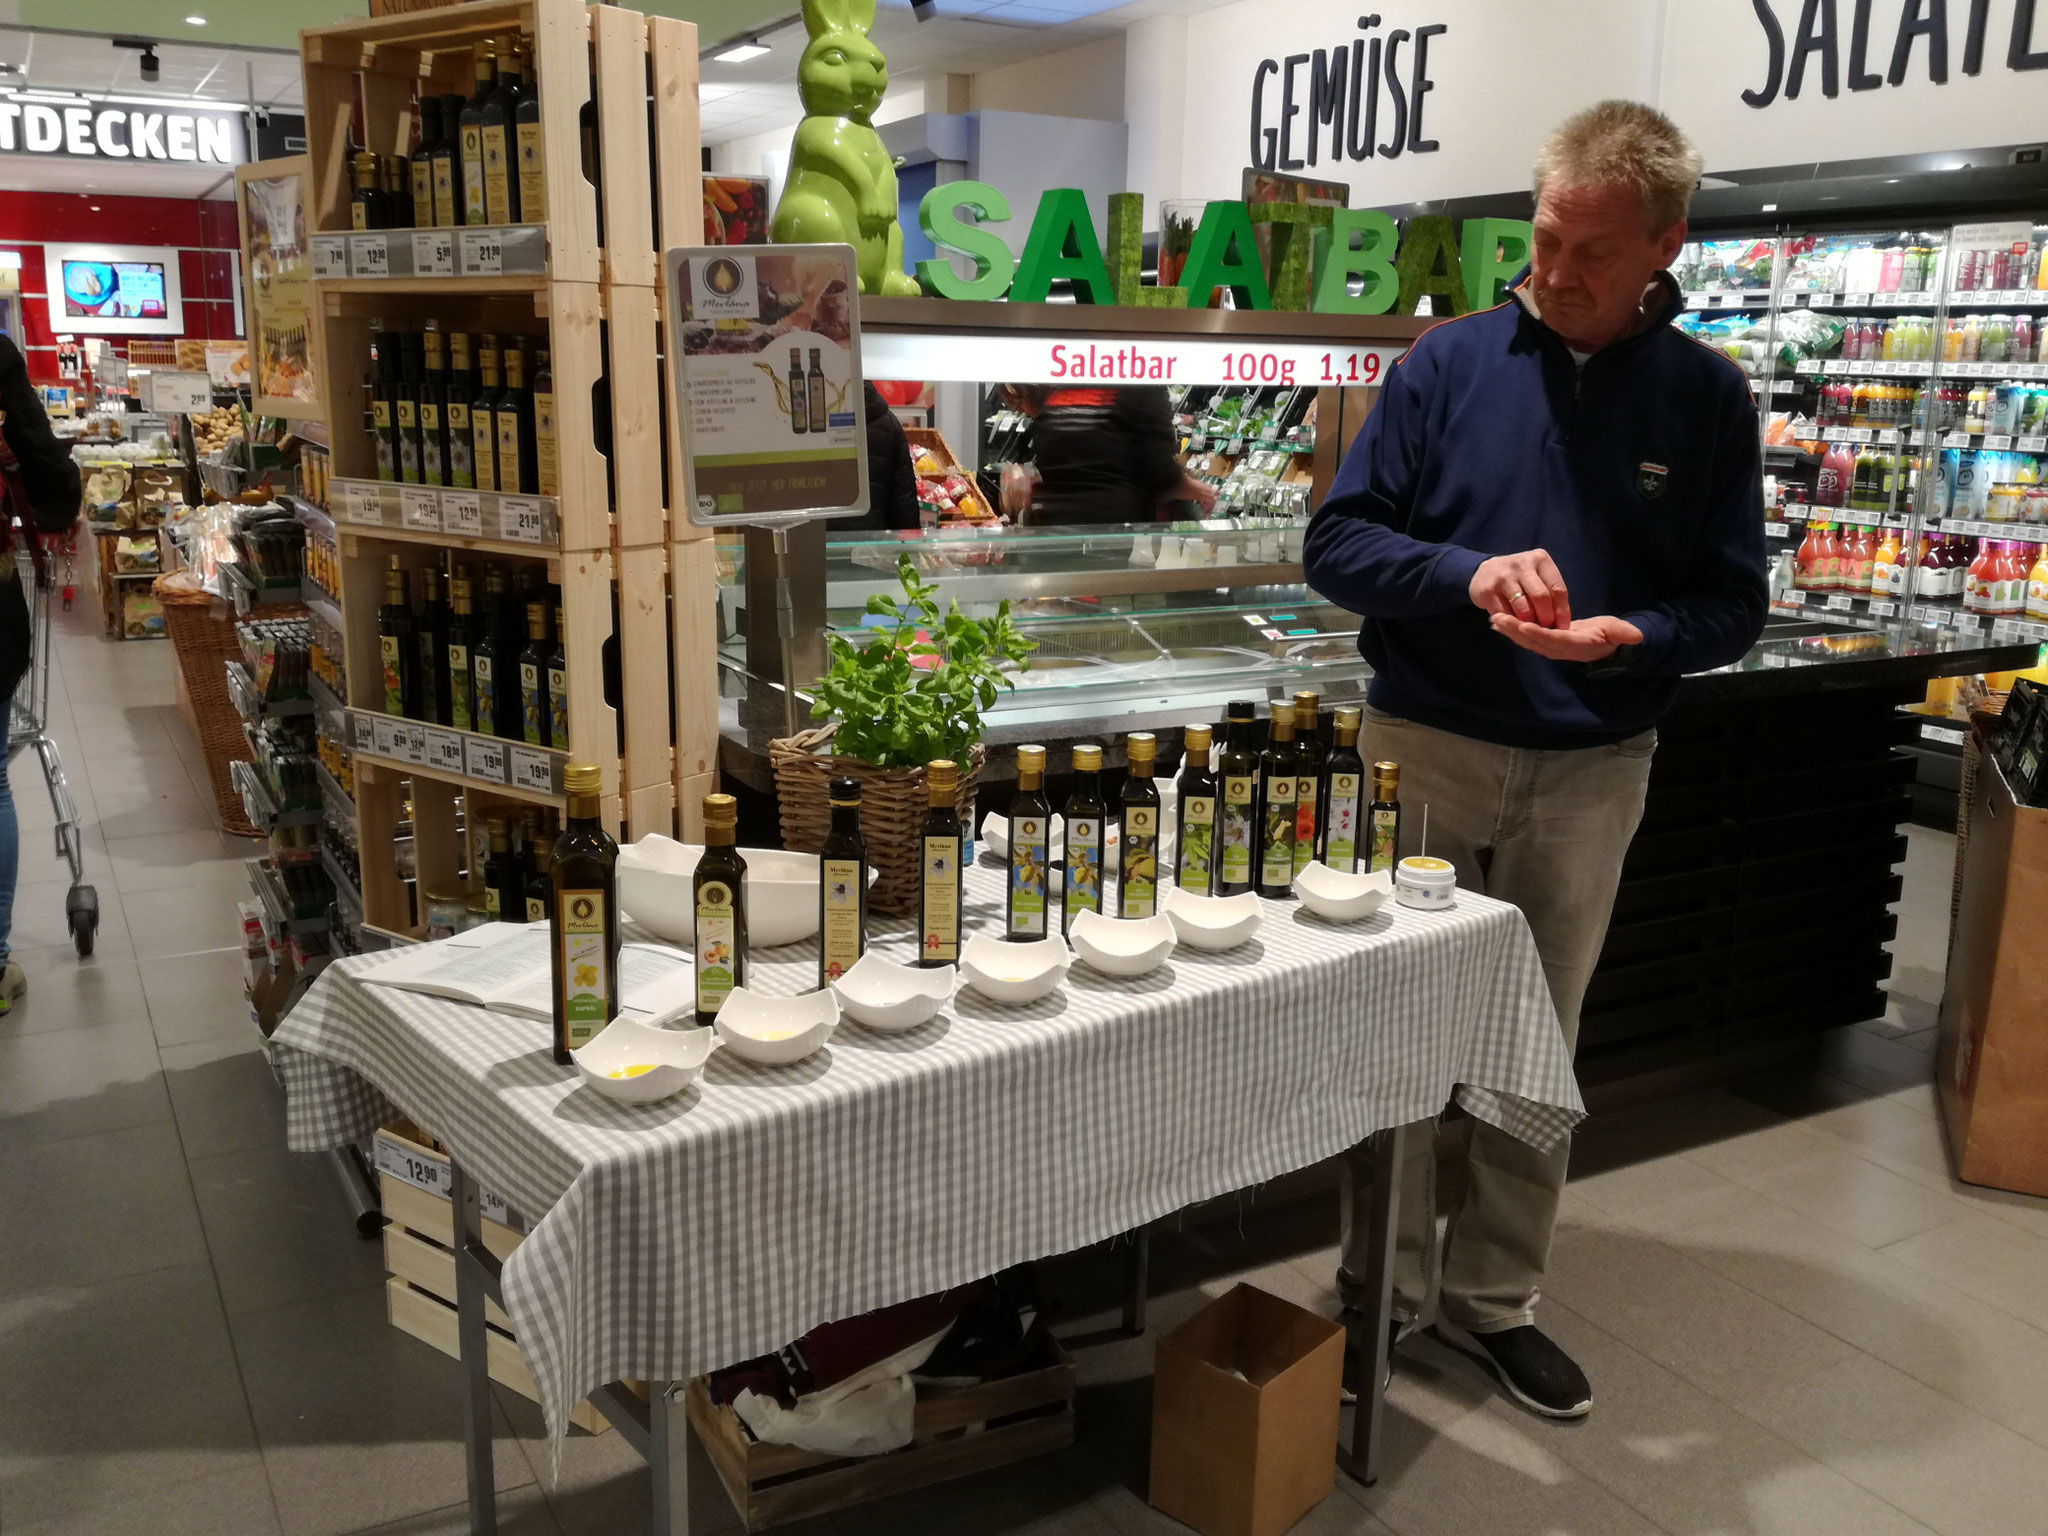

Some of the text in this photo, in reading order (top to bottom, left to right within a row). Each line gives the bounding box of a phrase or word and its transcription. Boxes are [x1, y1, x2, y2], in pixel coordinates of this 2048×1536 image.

[0, 103, 232, 163] TDECKEN
[1250, 14, 1448, 172] GEMÜSE
[915, 180, 1534, 316] SALATBAR
[1050, 344, 1380, 387] Salatbar 100g 1,19
